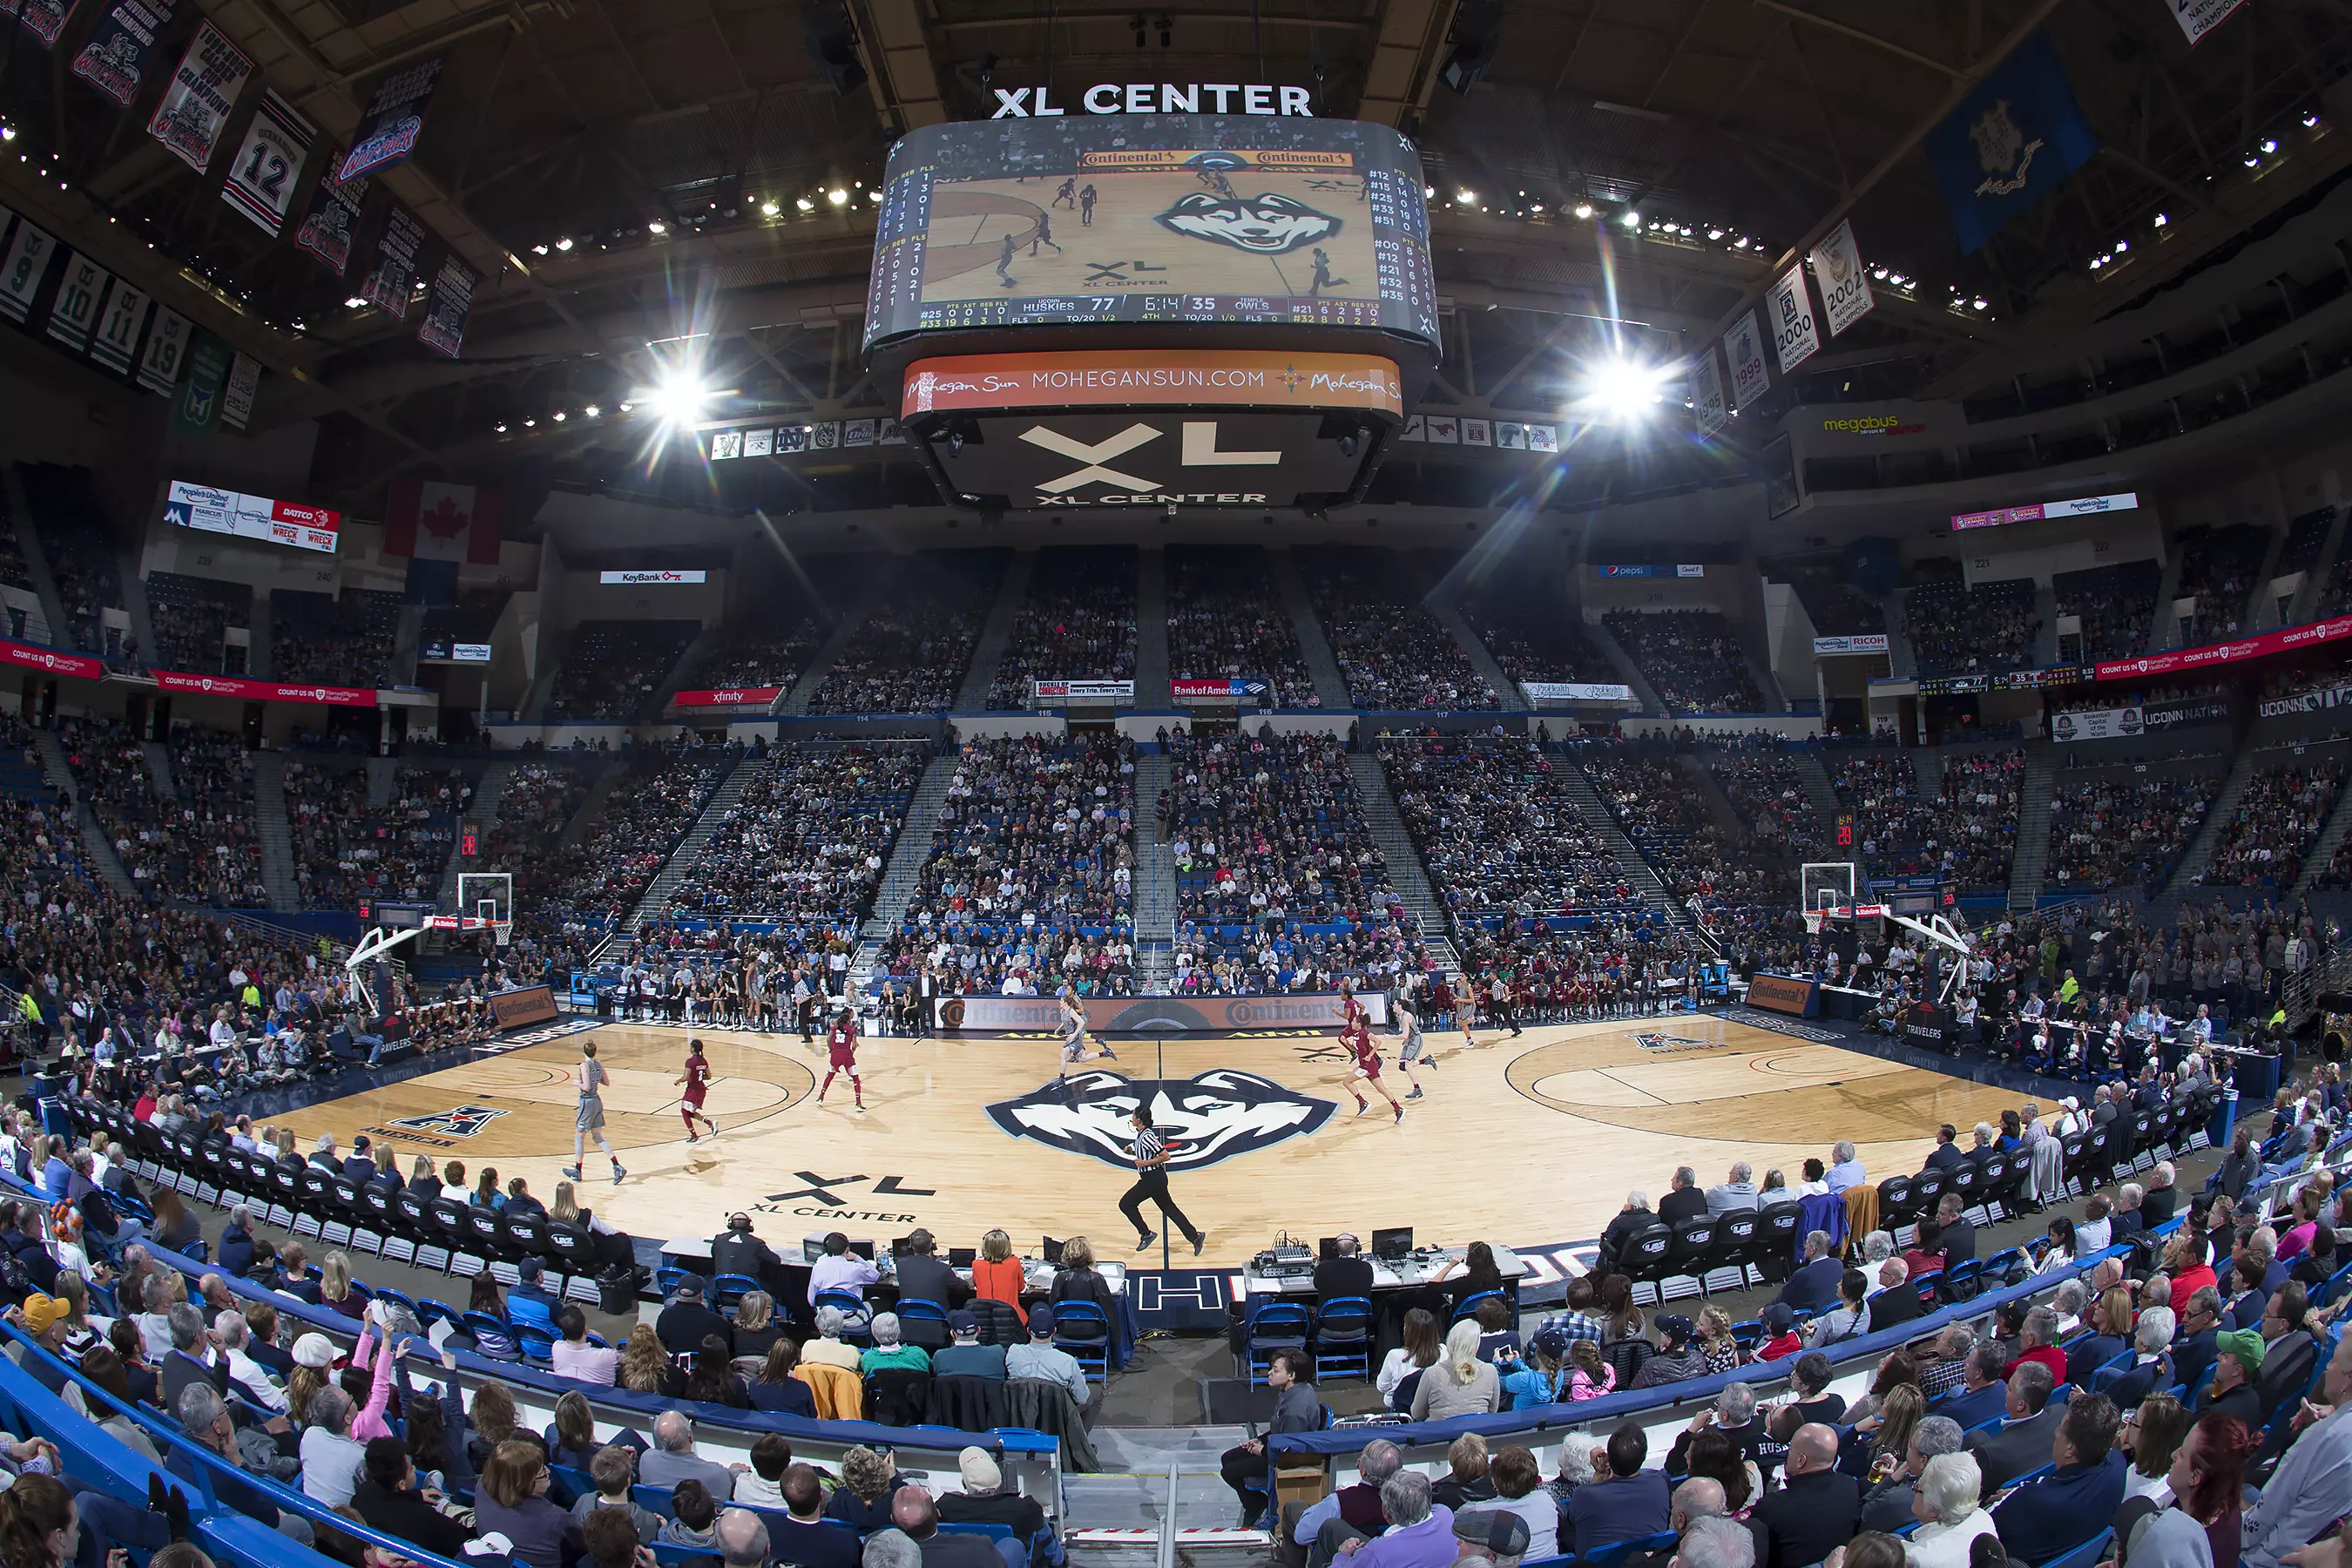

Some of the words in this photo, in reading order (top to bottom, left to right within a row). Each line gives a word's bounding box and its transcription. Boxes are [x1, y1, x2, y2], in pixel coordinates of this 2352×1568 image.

[2187, 0, 2214, 21] NATIO
[2193, 0, 2237, 36] CHAMPIO
[111, 6, 154, 47] CHAMPIONS
[177, 66, 233, 118] CHAMPIONS
[991, 87, 1064, 119] XL
[1083, 84, 1314, 118] CENTER
[1084, 152, 1162, 166] Continental
[1256, 152, 1335, 166] Continental
[244, 142, 289, 202] 12
[923, 172, 929, 181] 1
[1369, 170, 1389, 181] #12
[1398, 177, 1404, 186] 6
[921, 184, 928, 193] 3
[1370, 181, 1390, 192] #15
[1396, 186, 1408, 198] 14
[918, 195, 927, 204] 0
[1370, 192, 1393, 203] #25
[1400, 199, 1408, 208] 0
[919, 206, 924, 215] 1
[1372, 204, 1394, 214] #33
[1400, 209, 1410, 220] 19
[918, 218, 923, 226] 1
[1374, 215, 1394, 226] #51
[1402, 222, 1410, 231] 0
[386, 230, 415, 258] DIVISION
[1375, 240, 1399, 251] #00
[1406, 247, 1413, 255] 8
[379, 239, 415, 273] CHAMPIONS
[1378, 252, 1398, 263] #12
[1407, 259, 1415, 267] 0
[10, 256, 32, 294] 9
[1085, 261, 1167, 281] XL
[1379, 264, 1400, 275] #21
[1409, 271, 1416, 280] 6
[1380, 277, 1402, 288] #32
[1410, 284, 1417, 293] 8
[1828, 271, 1863, 312] 2002
[60, 284, 91, 323] 10
[1091, 298, 1115, 311] 77
[1145, 297, 1179, 311] 6:14
[1192, 297, 1215, 311] 35
[1381, 289, 1403, 301] #35
[1411, 296, 1418, 306] 0
[921, 310, 942, 319] #25
[1024, 302, 1075, 312] HUSKIES
[1234, 302, 1269, 311] OWLS
[1293, 305, 1312, 314] #21
[1835, 294, 1863, 320] NATIONAL
[920, 320, 942, 328] #33
[1293, 314, 1315, 323] #32
[1835, 301, 1869, 331] CHAMPIONS
[106, 309, 132, 347] 11
[1778, 314, 1811, 352] 2000
[1784, 335, 1811, 359] NATIONAL
[148, 336, 176, 375] 19
[1784, 344, 1815, 369] CHAMPIONS
[1031, 369, 1265, 389] MOHEGANSUN.COM
[1736, 358, 1761, 388] 1999
[982, 375, 1020, 392] Sun
[1309, 373, 1387, 395] Mohegan
[1824, 416, 1898, 433] megabus
[1018, 422, 1282, 494] XL
[206, 490, 229, 503] United
[209, 498, 227, 508] Bank
[1035, 495, 1092, 506] XL
[1098, 493, 1267, 505] CENTER
[195, 508, 222, 517] MARCUS
[282, 507, 314, 520] DATTCO
[273, 527, 298, 539] WRECK
[308, 533, 333, 546] WRECK
[1619, 566, 1644, 576] pepsi
[1975, 559, 1990, 568] 221
[622, 572, 660, 583] KeyBank
[1854, 636, 1884, 645] RICOH
[2282, 633, 2301, 643] COUNT
[13, 649, 30, 659] COUNT
[2101, 666, 2121, 674] COUNT
[713, 692, 744, 703] xfinity
[1174, 686, 1197, 696] Bank
[1206, 686, 1243, 695] America
[2260, 698, 2302, 718] UCONN
[2146, 709, 2184, 725] UCONN
[1837, 826, 1851, 846] 28
[462, 835, 476, 855] 28
[1751, 981, 1801, 1004] Continental
[497, 994, 544, 1021] Continental
[472, 1020, 604, 1053] HUSKIES
[835, 1033, 845, 1044] 32
[1906, 1024, 1942, 1039] TRAVELERS
[380, 1037, 412, 1054] RAVELERS
[359, 1125, 458, 1148] AMERICAN
[764, 1171, 937, 1207] XL
[747, 1203, 785, 1214] XL
[793, 1207, 917, 1223] CENTER
